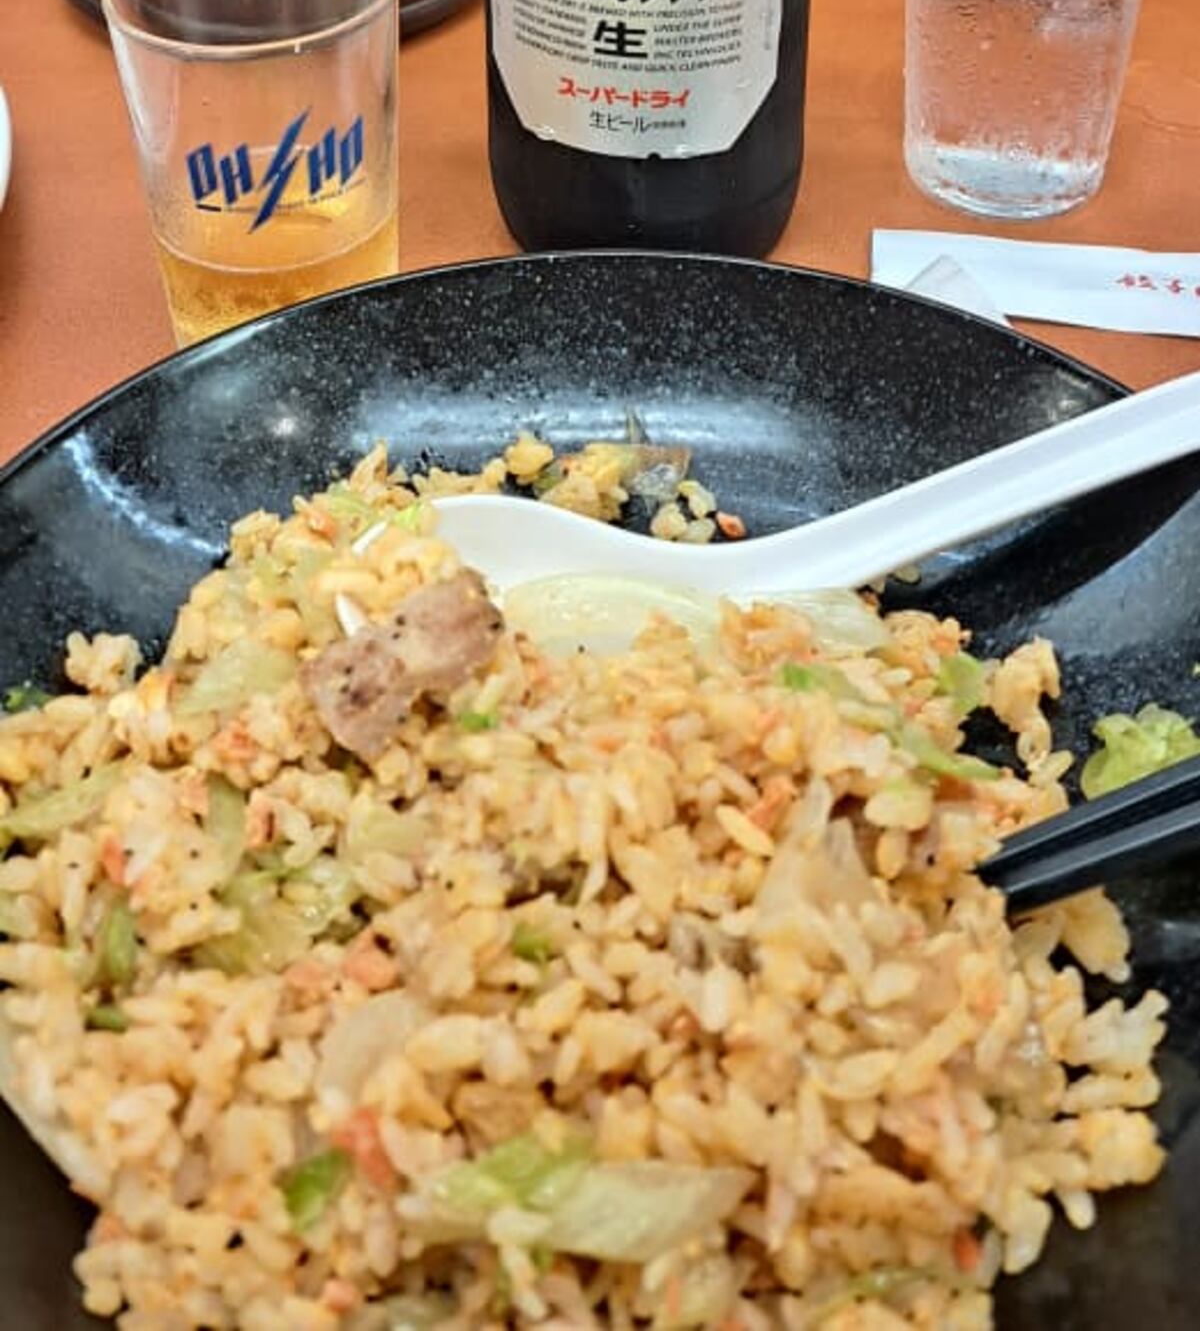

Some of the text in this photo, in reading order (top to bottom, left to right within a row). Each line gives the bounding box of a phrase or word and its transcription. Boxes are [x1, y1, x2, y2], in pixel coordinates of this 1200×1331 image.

[593, 20, 649, 59] 生
[558, 76, 691, 108] スーパードライ
[589, 109, 651, 134] 生ビール
